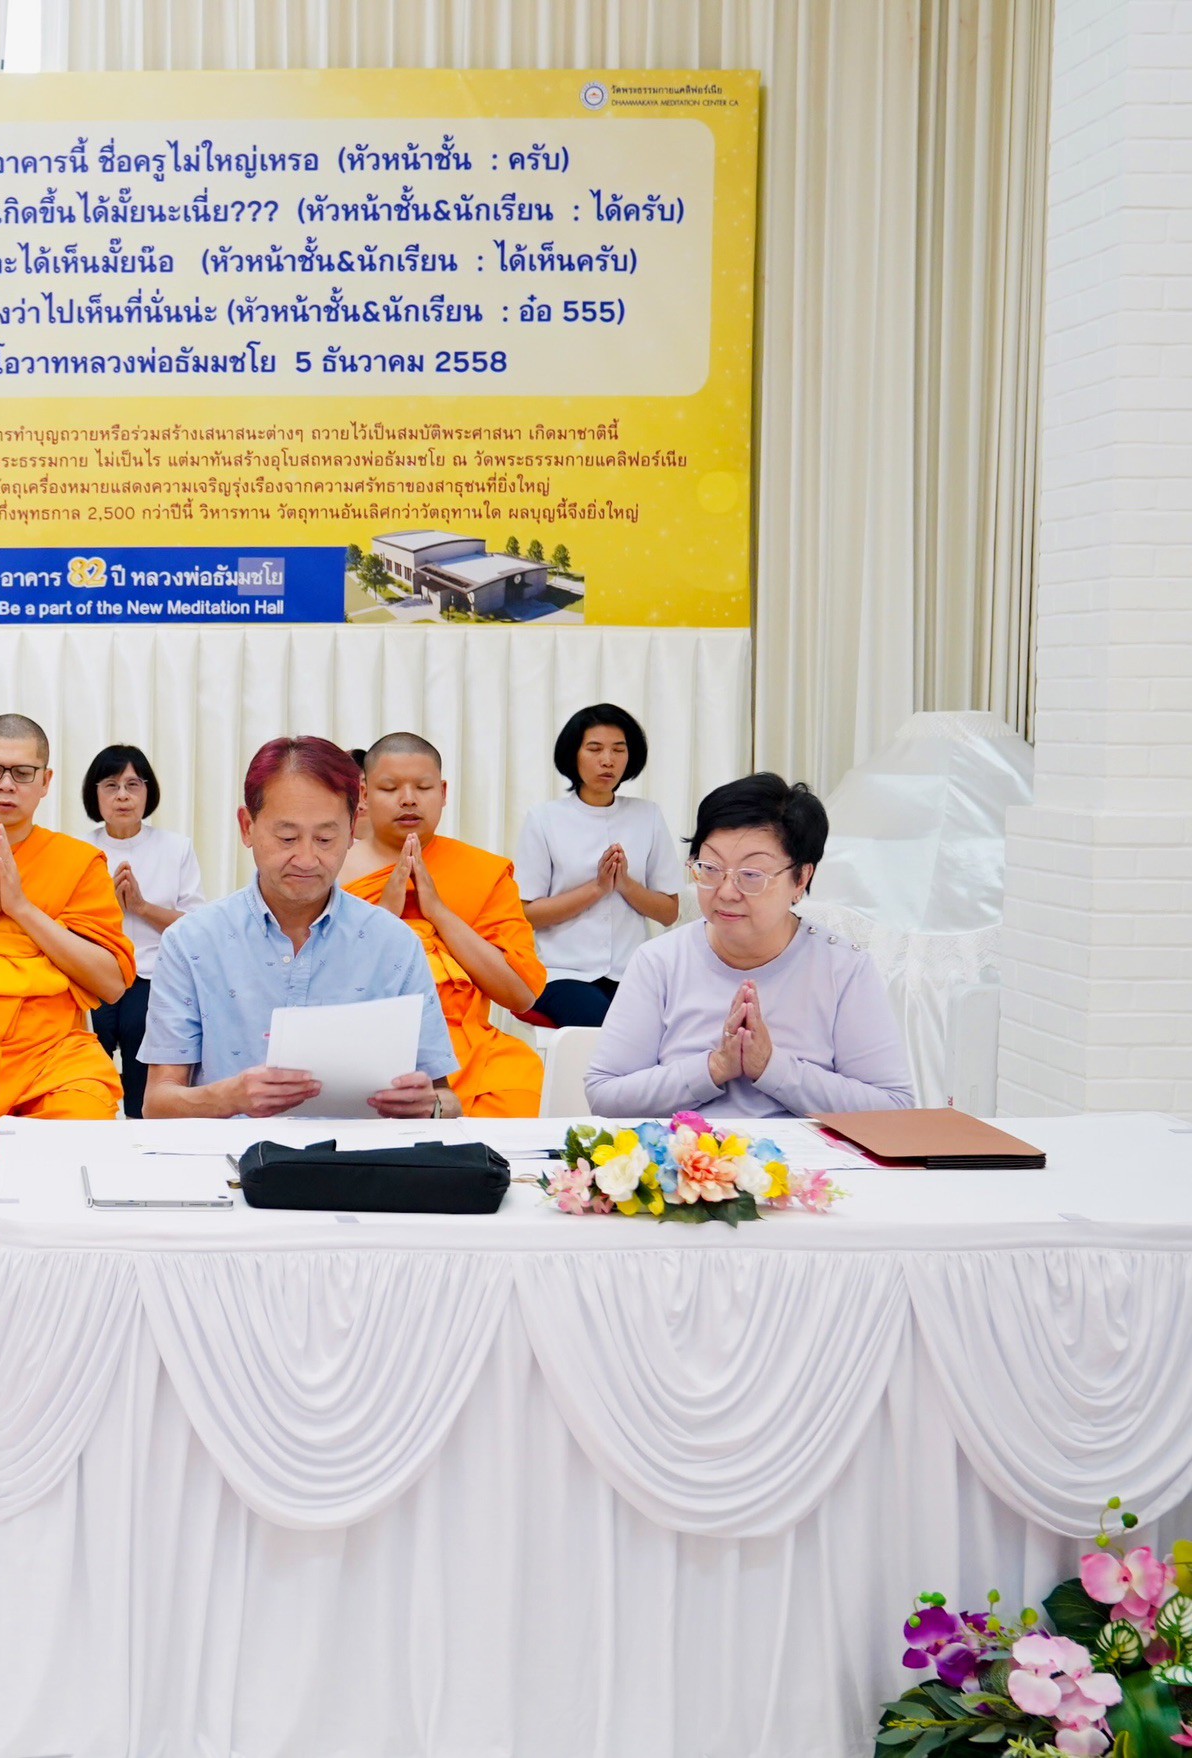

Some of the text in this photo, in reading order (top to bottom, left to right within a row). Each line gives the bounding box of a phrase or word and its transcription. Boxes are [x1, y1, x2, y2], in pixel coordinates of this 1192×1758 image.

[338, 134, 472, 174] (หัวหน้าชั้น
[519, 294, 552, 323] อ๋อ
[563, 298, 625, 326] 555)
[295, 351, 312, 373] 5
[322, 345, 424, 373] ธันวาคม
[435, 350, 507, 373] 2558
[529, 418, 619, 441] เกิดมาชาตินี้
[94, 448, 160, 467] ไม่เป็นไร
[452, 455, 468, 467] ณ
[88, 506, 135, 521] 2,500
[142, 498, 194, 520] กว่าปีนี้
[199, 503, 271, 520] วิหารทาน
[0, 556, 284, 588] อาคาร 82 ปี หลวงพ่อธัมมชโย
[25, 603, 36, 616] a
[38, 600, 73, 619] part
[75, 600, 93, 615] of
[96, 600, 123, 615] the
[127, 600, 164, 615] New
[167, 599, 250, 615] Meditation
[254, 599, 284, 615] Hall
